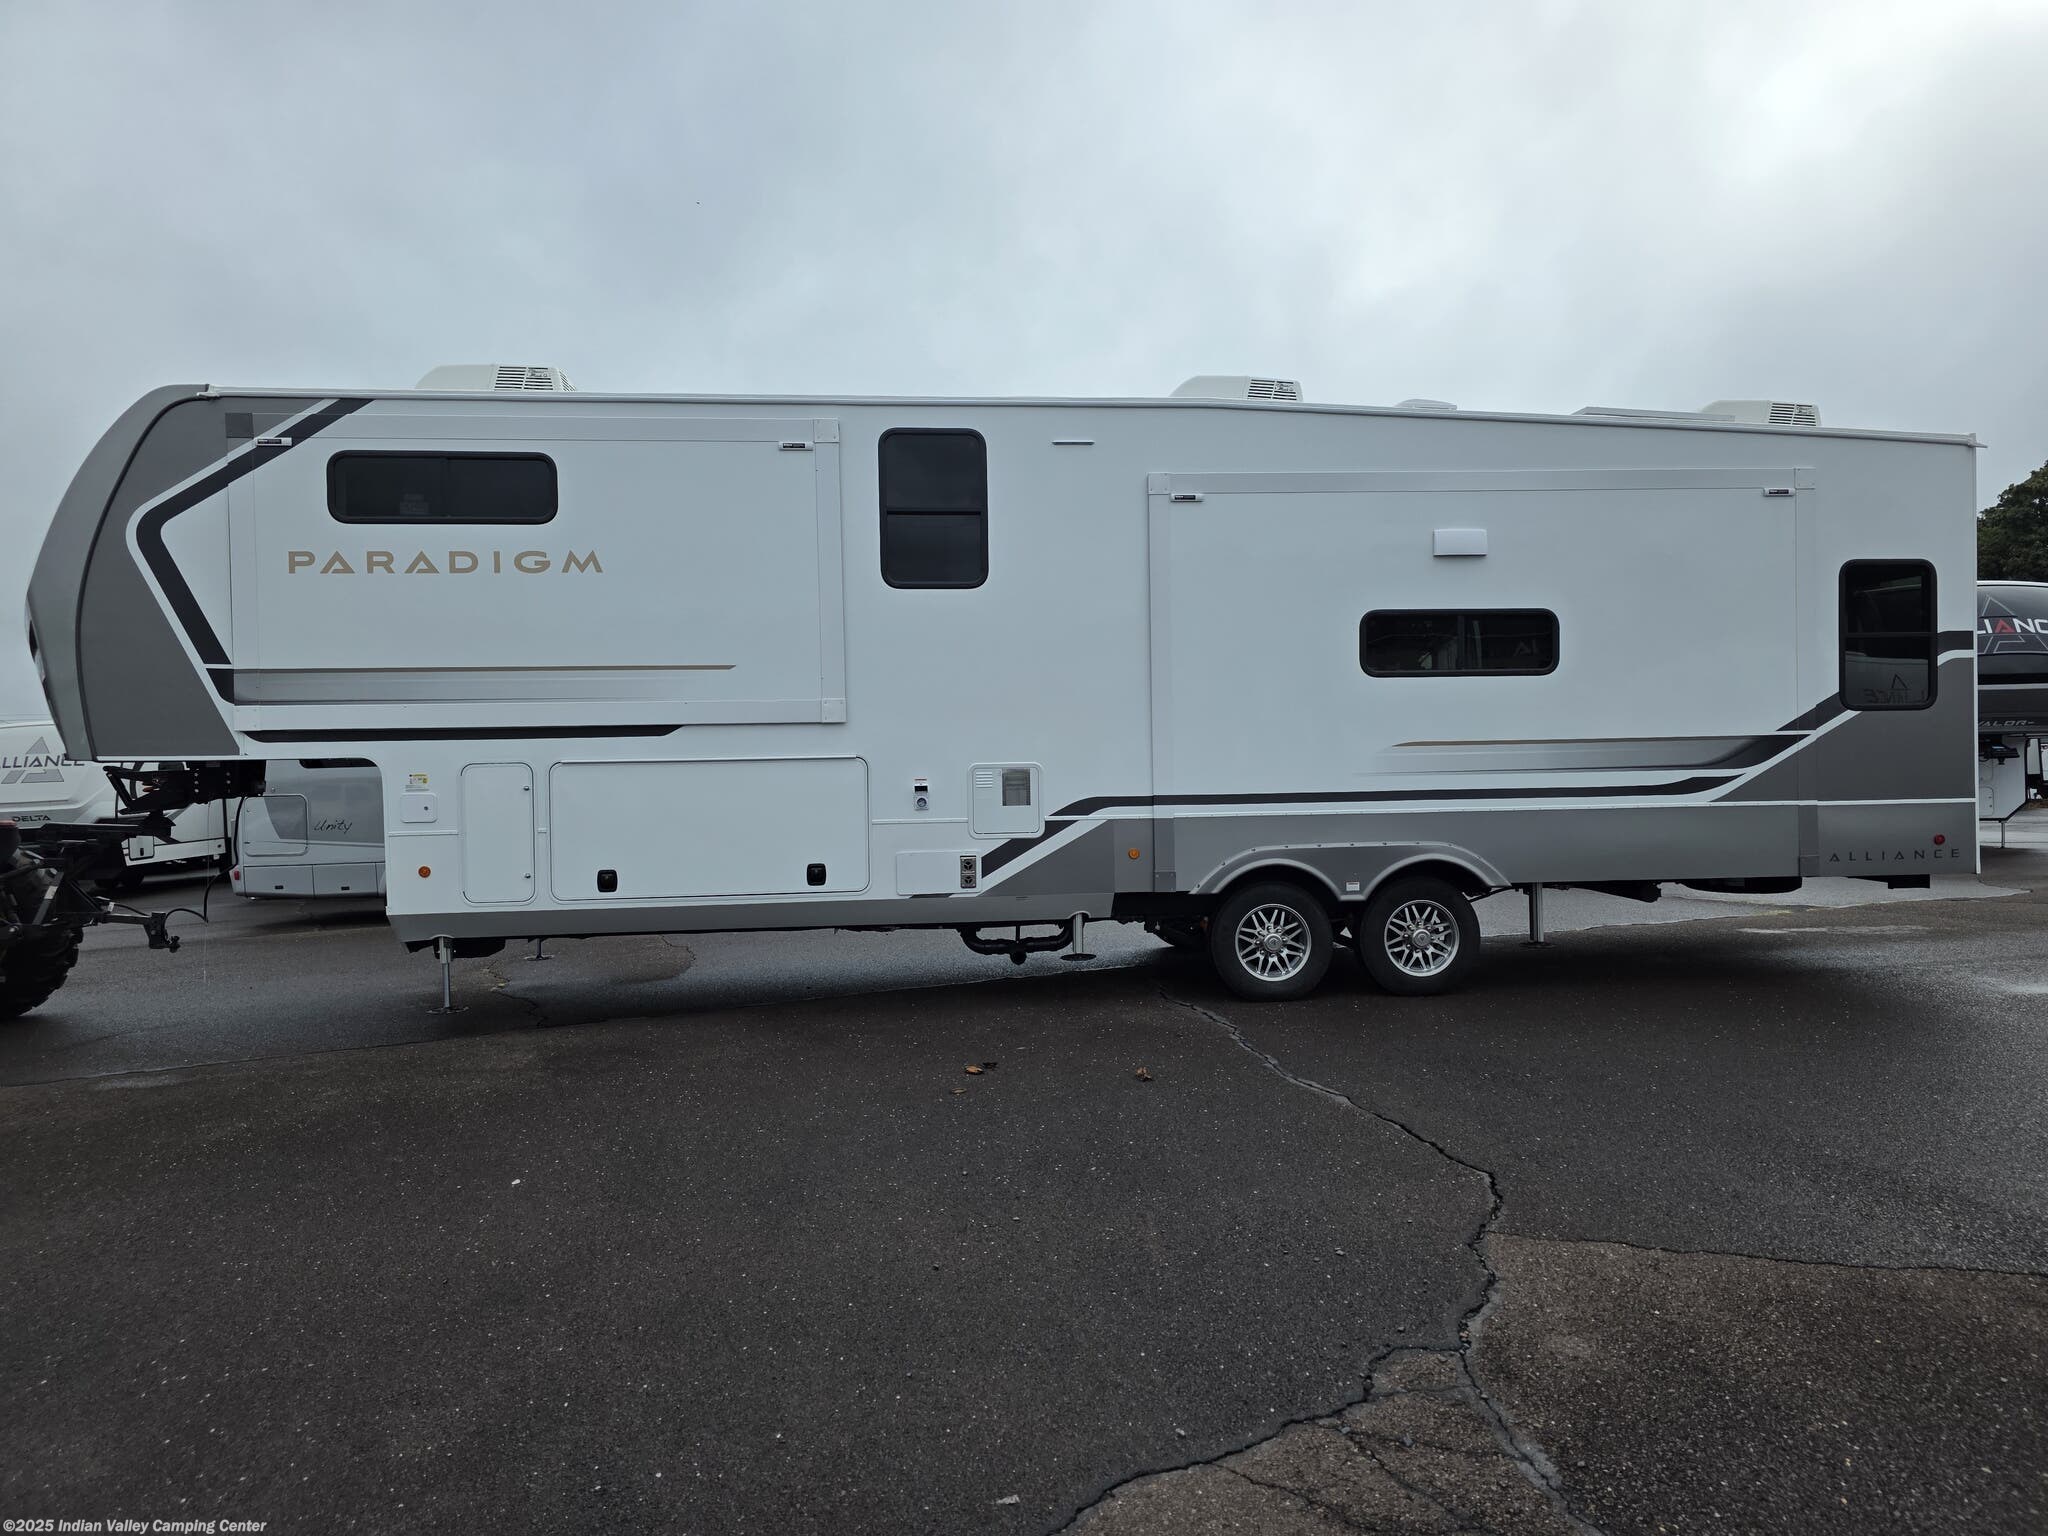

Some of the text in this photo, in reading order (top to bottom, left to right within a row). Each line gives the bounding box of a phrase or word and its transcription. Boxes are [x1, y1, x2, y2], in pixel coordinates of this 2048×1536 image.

[287, 549, 604, 574] PARADIGM
[0, 754, 86, 769] LLIANC
[12, 814, 51, 822] DELTA
[313, 818, 353, 835] Unity
[1828, 848, 1961, 863] ALLIANCE
